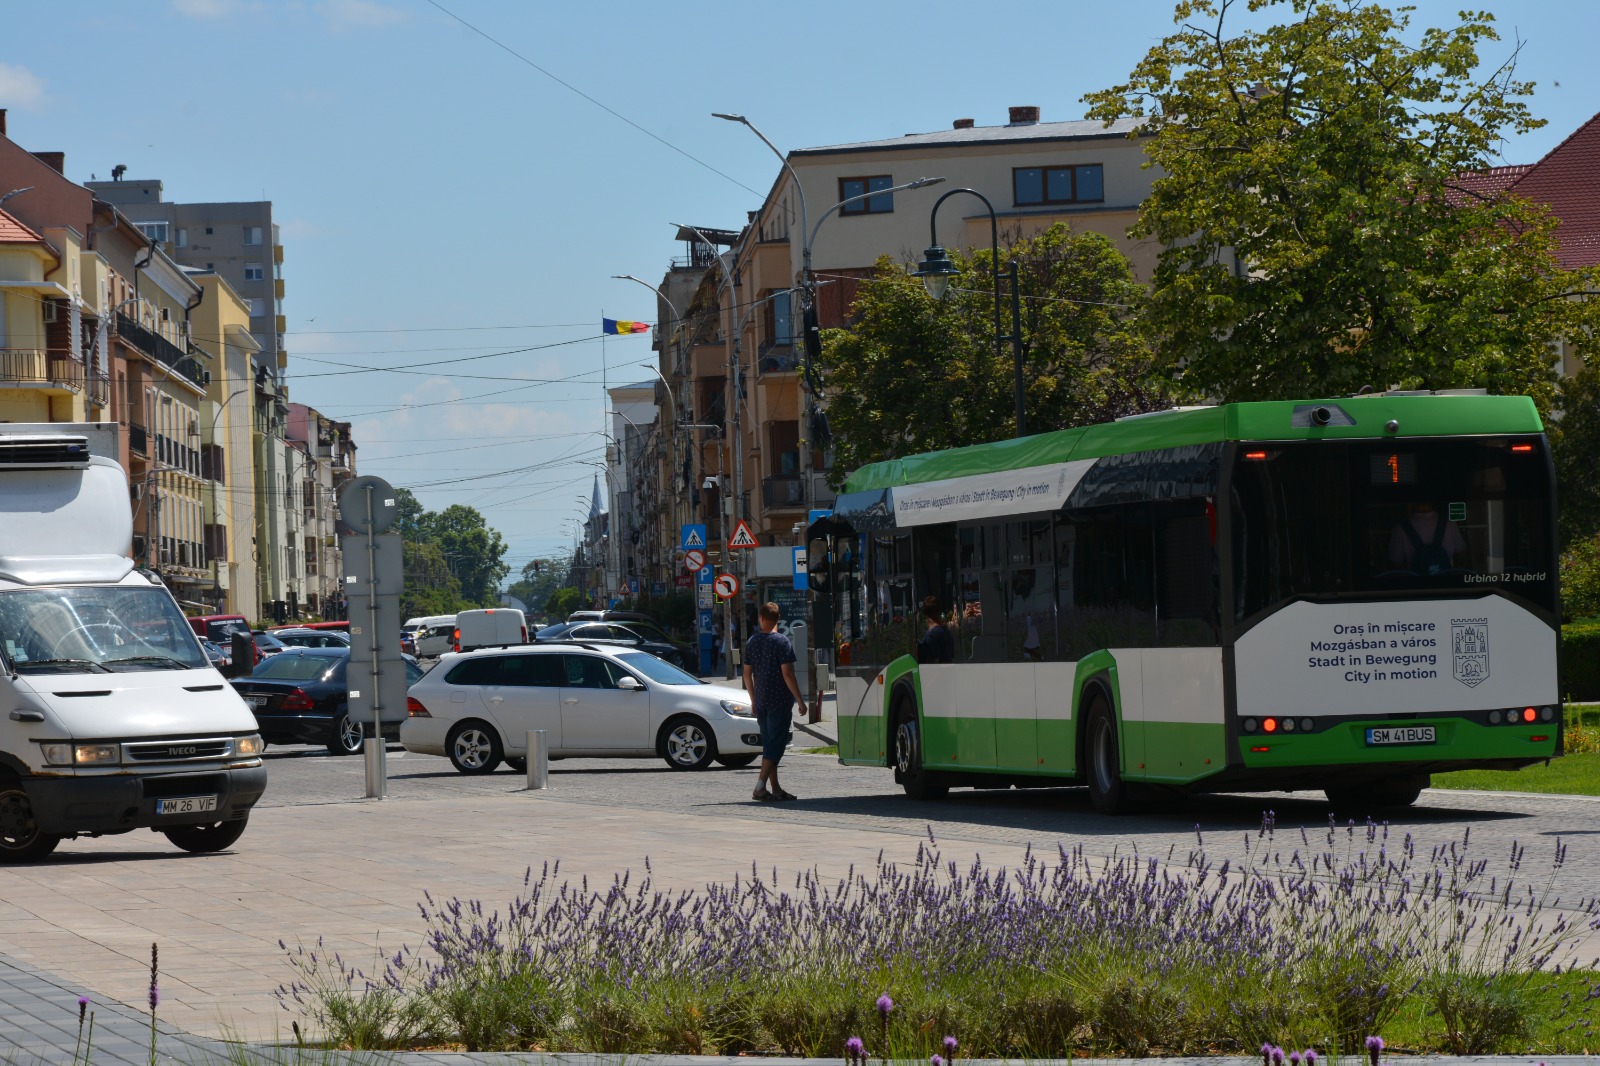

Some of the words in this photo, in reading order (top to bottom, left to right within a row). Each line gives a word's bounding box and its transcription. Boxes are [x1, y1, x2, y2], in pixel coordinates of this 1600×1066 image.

[1388, 454, 1398, 483] 1
[1463, 573, 1498, 583] Urbino
[1500, 573, 1511, 582] 12
[1513, 572, 1546, 583] hybrid
[1333, 623, 1364, 637] Oraș
[1367, 622, 1380, 634] în
[1384, 621, 1436, 635] mișcare
[1310, 637, 1386, 654] Mozgásban
[1390, 640, 1398, 648] a
[1401, 636, 1436, 648] város
[1309, 656, 1345, 668] Stadt
[1349, 655, 1362, 665] in
[1365, 653, 1437, 667] Bewegung
[1344, 670, 1370, 684] City
[1374, 669, 1387, 681] in
[1390, 668, 1437, 680] motion
[1373, 730, 1390, 742] SM
[1393, 729, 1406, 741] 41
[1407, 728, 1433, 741] BUS
[169, 746, 196, 755] IVECO
[163, 801, 177, 813] MM
[181, 800, 192, 811] 26
[199, 798, 214, 810] VIF
